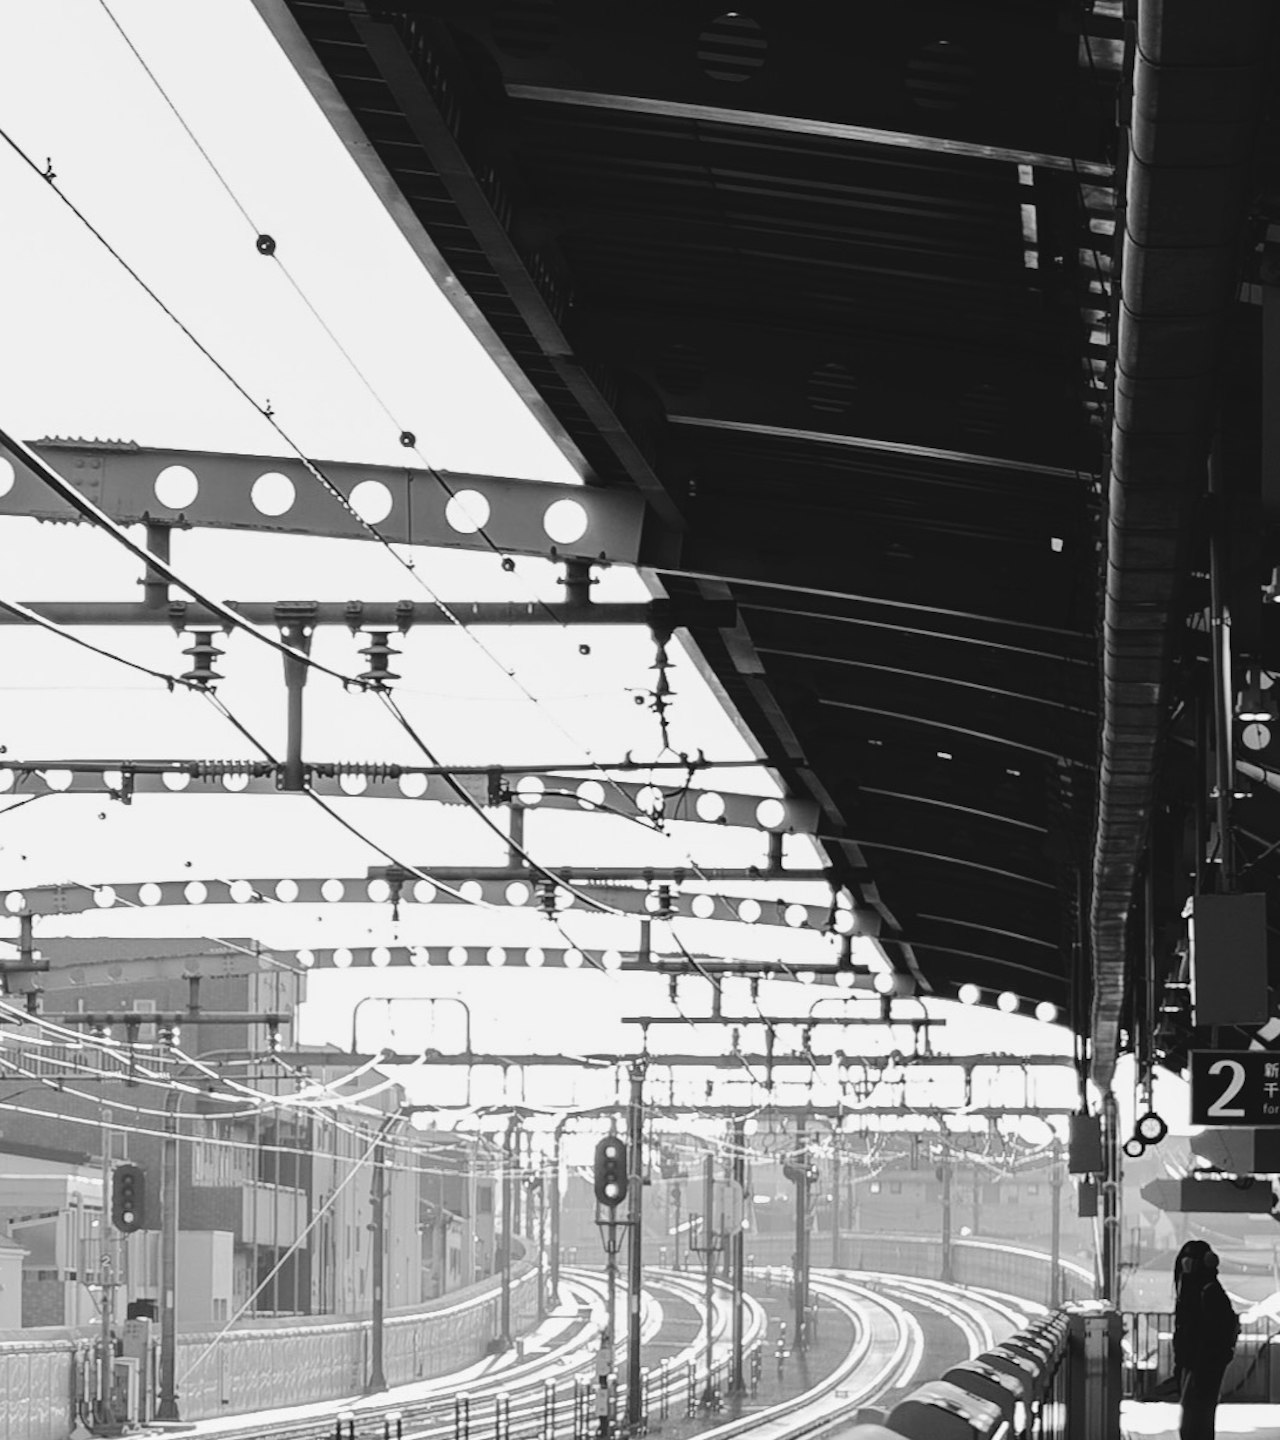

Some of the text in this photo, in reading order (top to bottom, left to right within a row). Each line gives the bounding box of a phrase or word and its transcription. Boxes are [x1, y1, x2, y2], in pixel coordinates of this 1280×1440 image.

[1264, 1062, 1280, 1079] 新
[1207, 1059, 1246, 1117] 2
[1262, 1102, 1280, 1115] for
[102, 1255, 111, 1267] 2
